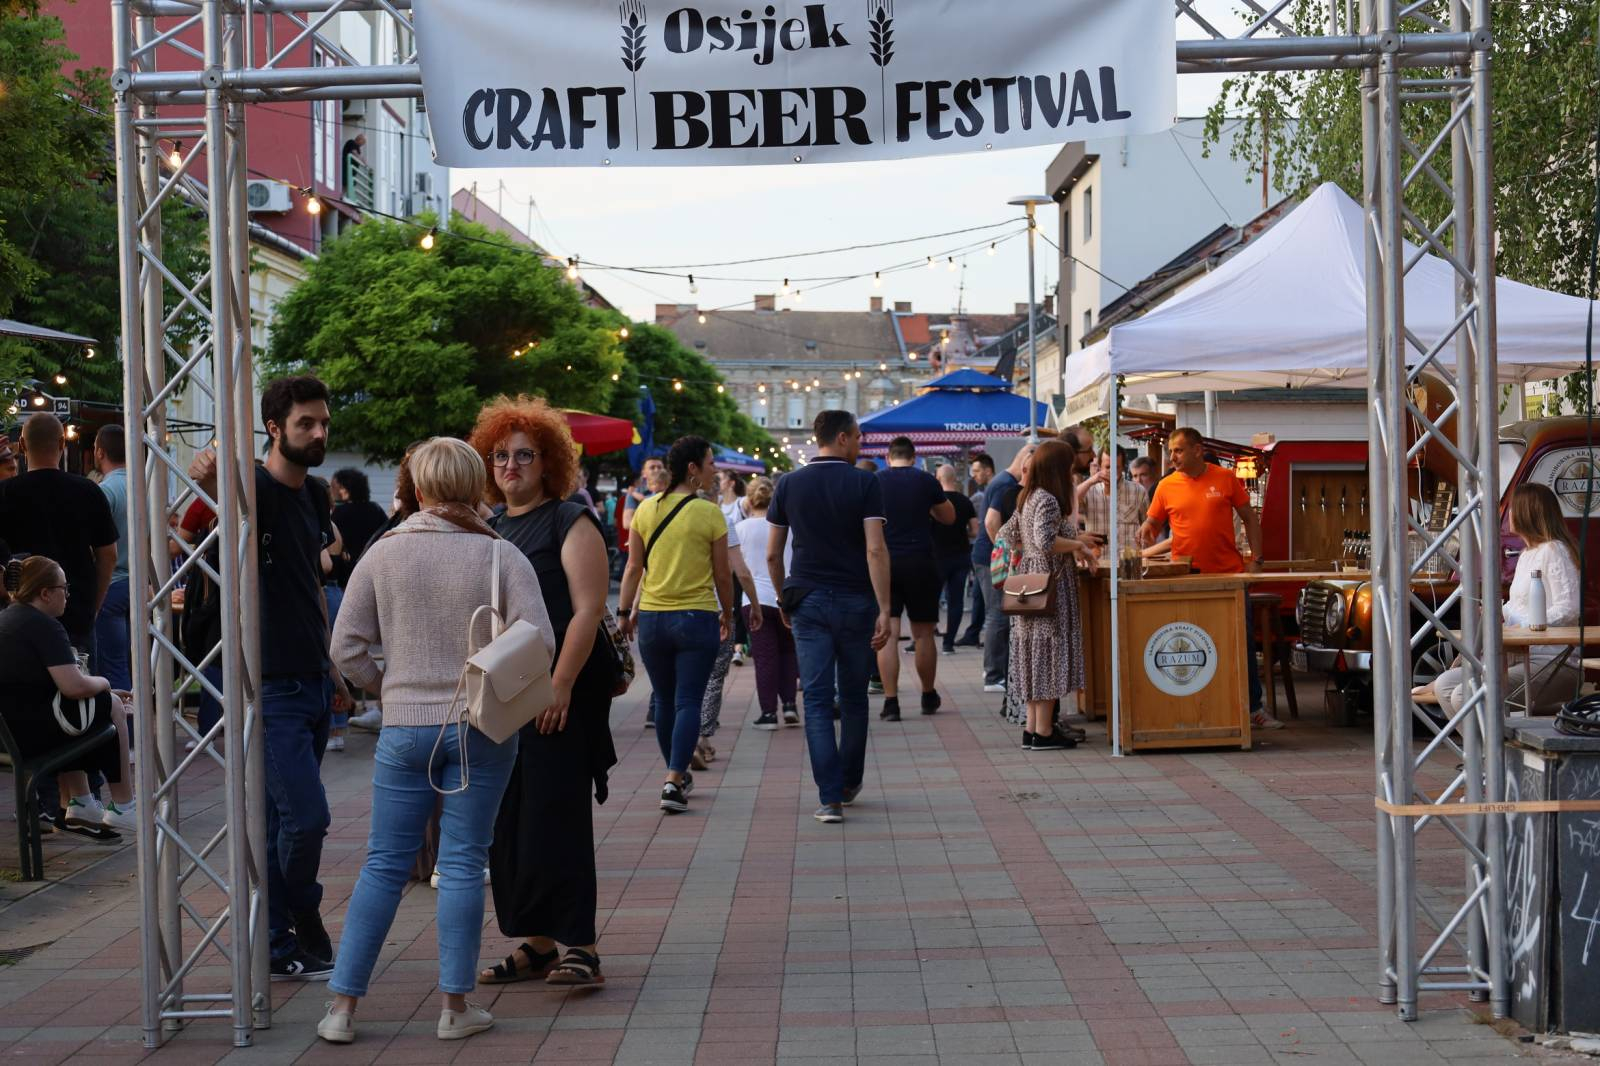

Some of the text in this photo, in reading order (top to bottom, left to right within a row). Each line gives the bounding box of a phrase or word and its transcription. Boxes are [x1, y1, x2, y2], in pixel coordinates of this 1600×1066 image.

[664, 3, 851, 65] Osijek
[462, 66, 1132, 151] CRAFT BEER FESTIVAL
[943, 422, 987, 431] TRŽNICA
[1562, 479, 1600, 491] RAZ
[1161, 654, 1200, 664] RAZUM
